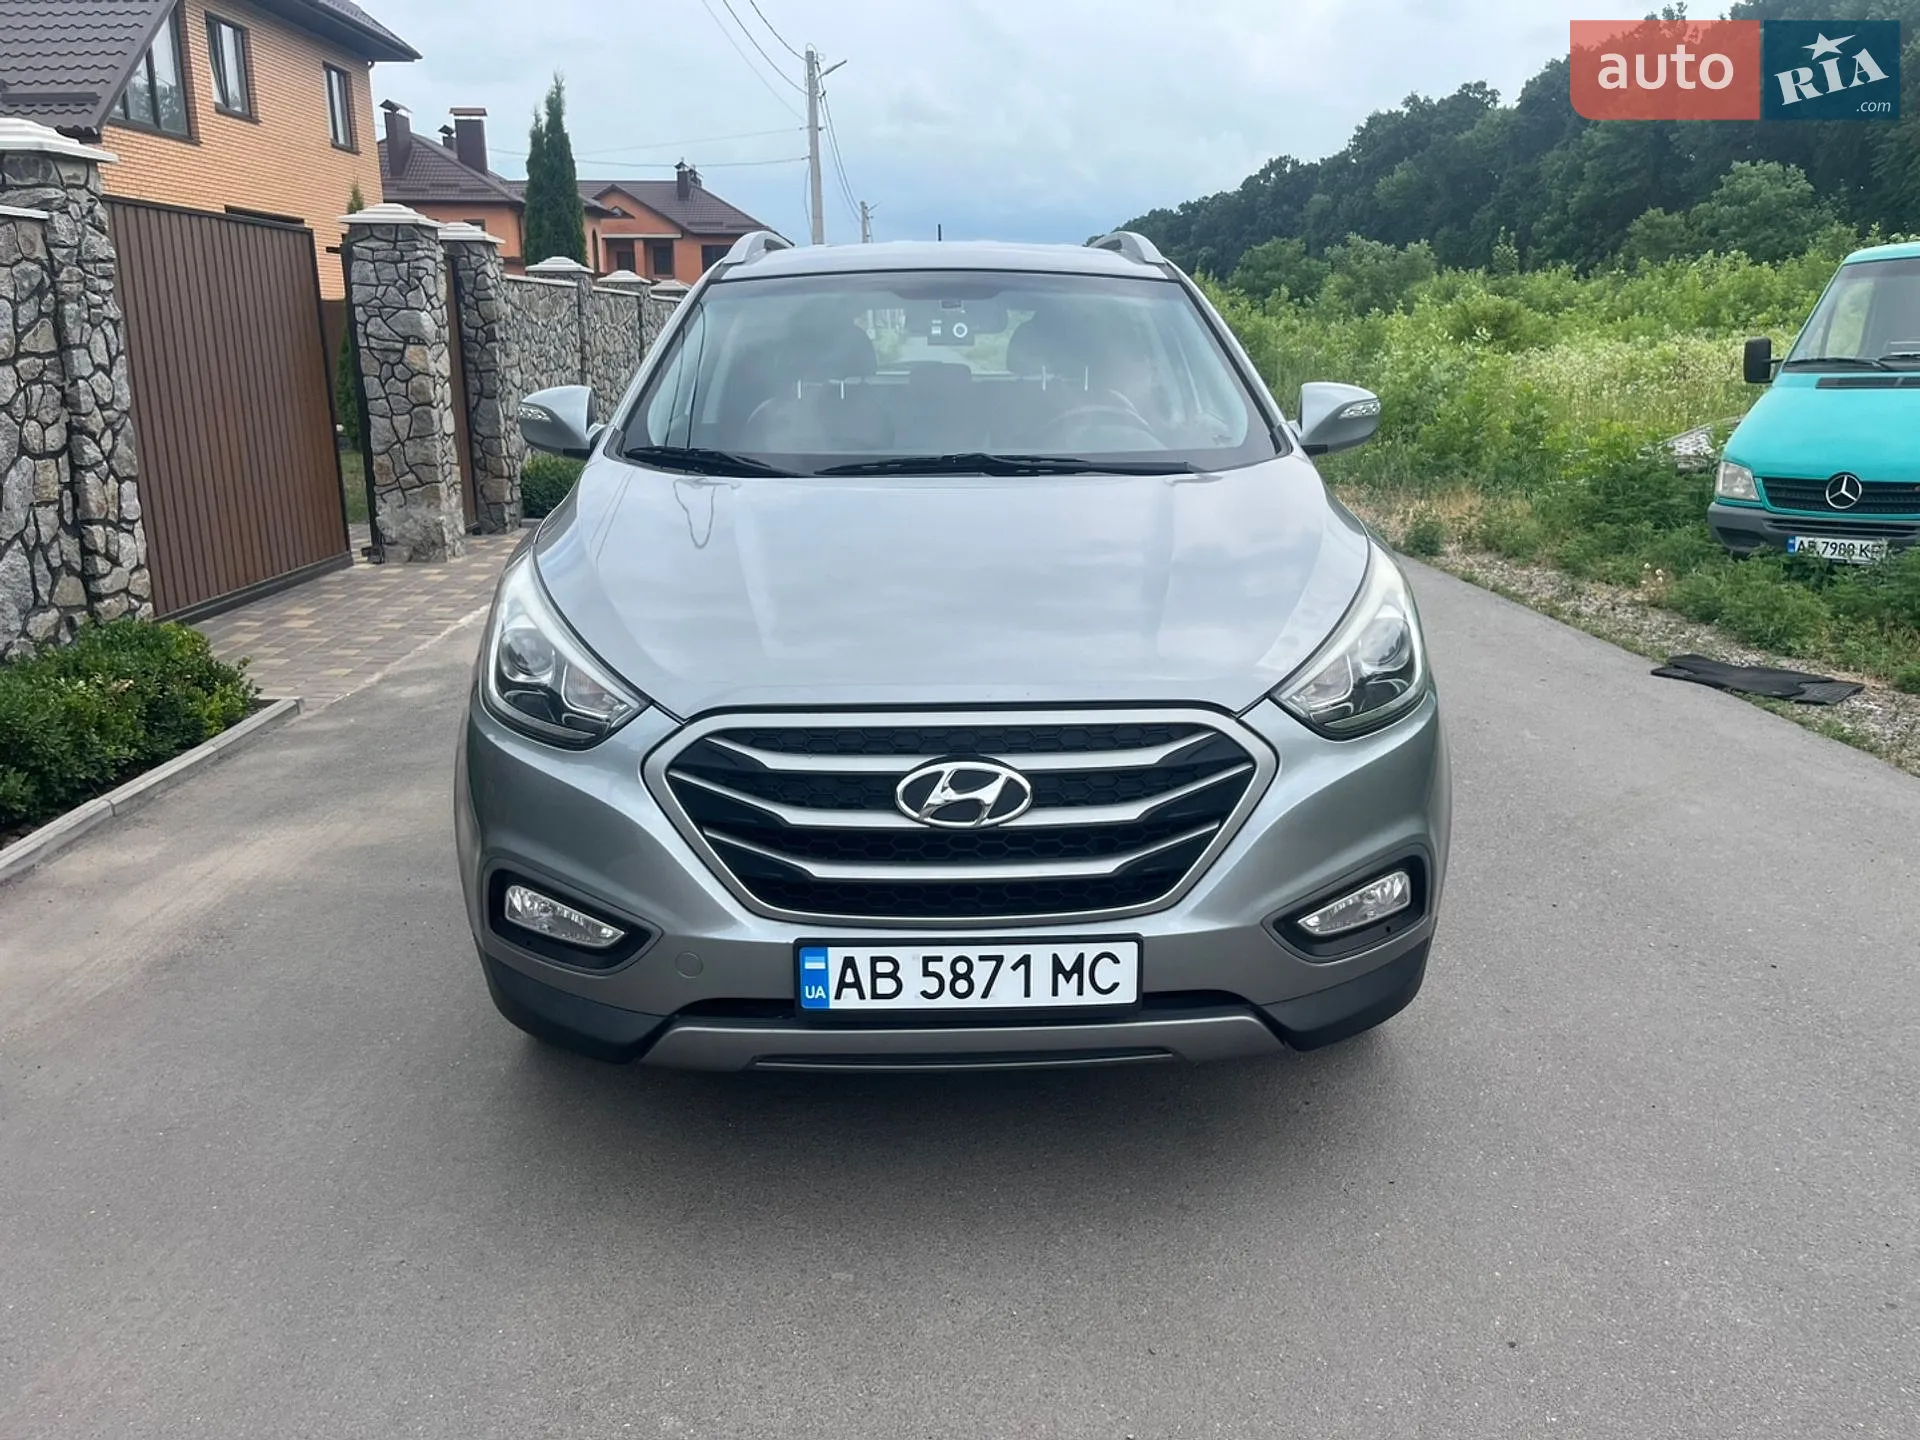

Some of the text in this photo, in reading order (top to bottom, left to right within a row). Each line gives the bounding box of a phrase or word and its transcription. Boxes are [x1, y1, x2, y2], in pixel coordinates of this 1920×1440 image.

[805, 985, 827, 999] UA
[834, 951, 1121, 1001] AB 5871 MC
